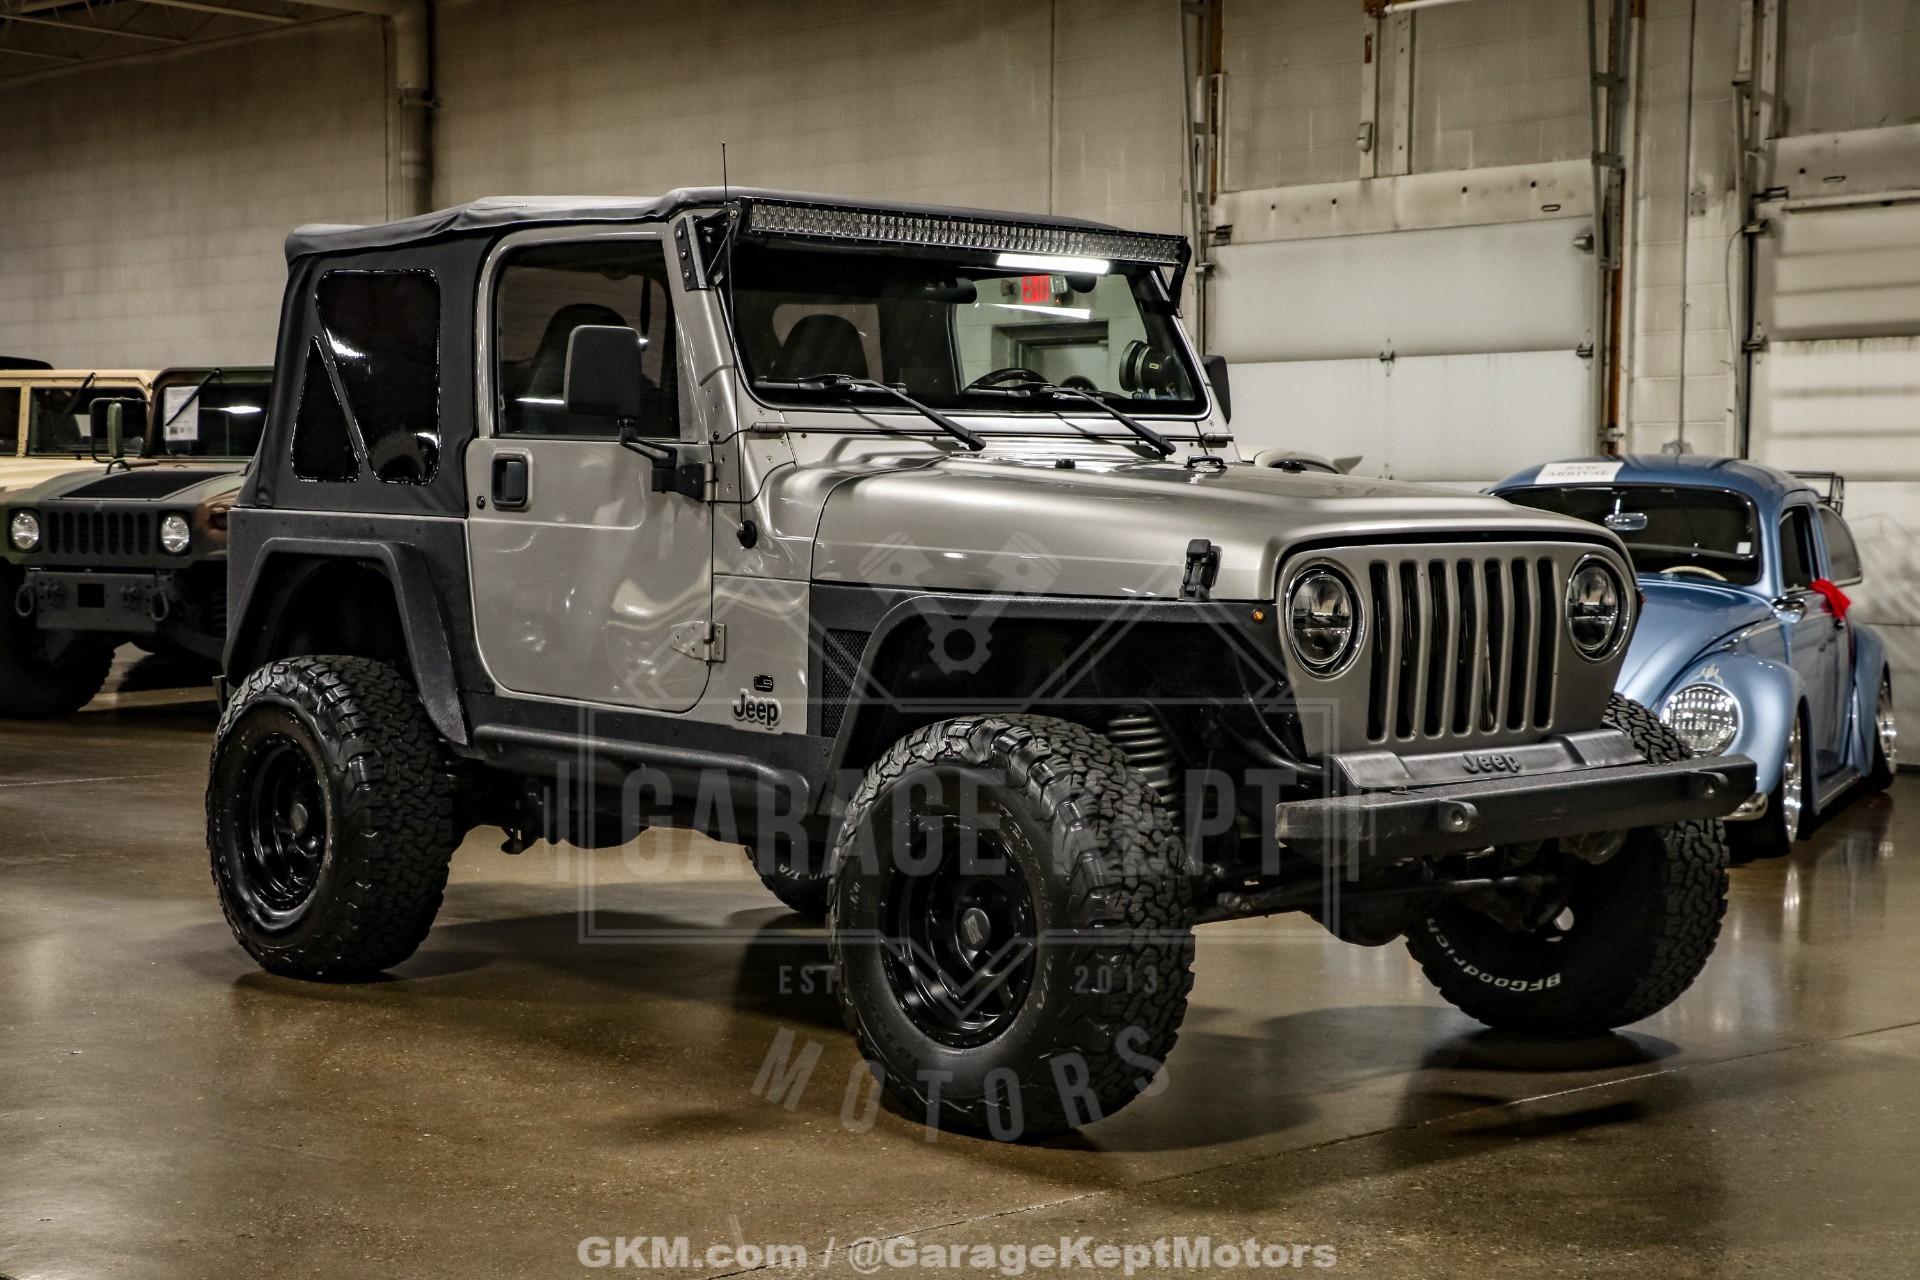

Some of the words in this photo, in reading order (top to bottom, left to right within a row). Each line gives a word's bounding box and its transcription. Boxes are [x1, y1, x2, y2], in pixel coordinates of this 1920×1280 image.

[733, 690, 781, 728] Jeep
[1462, 753, 1520, 774] Jeep
[1427, 918, 1561, 992] BFGoodrich
